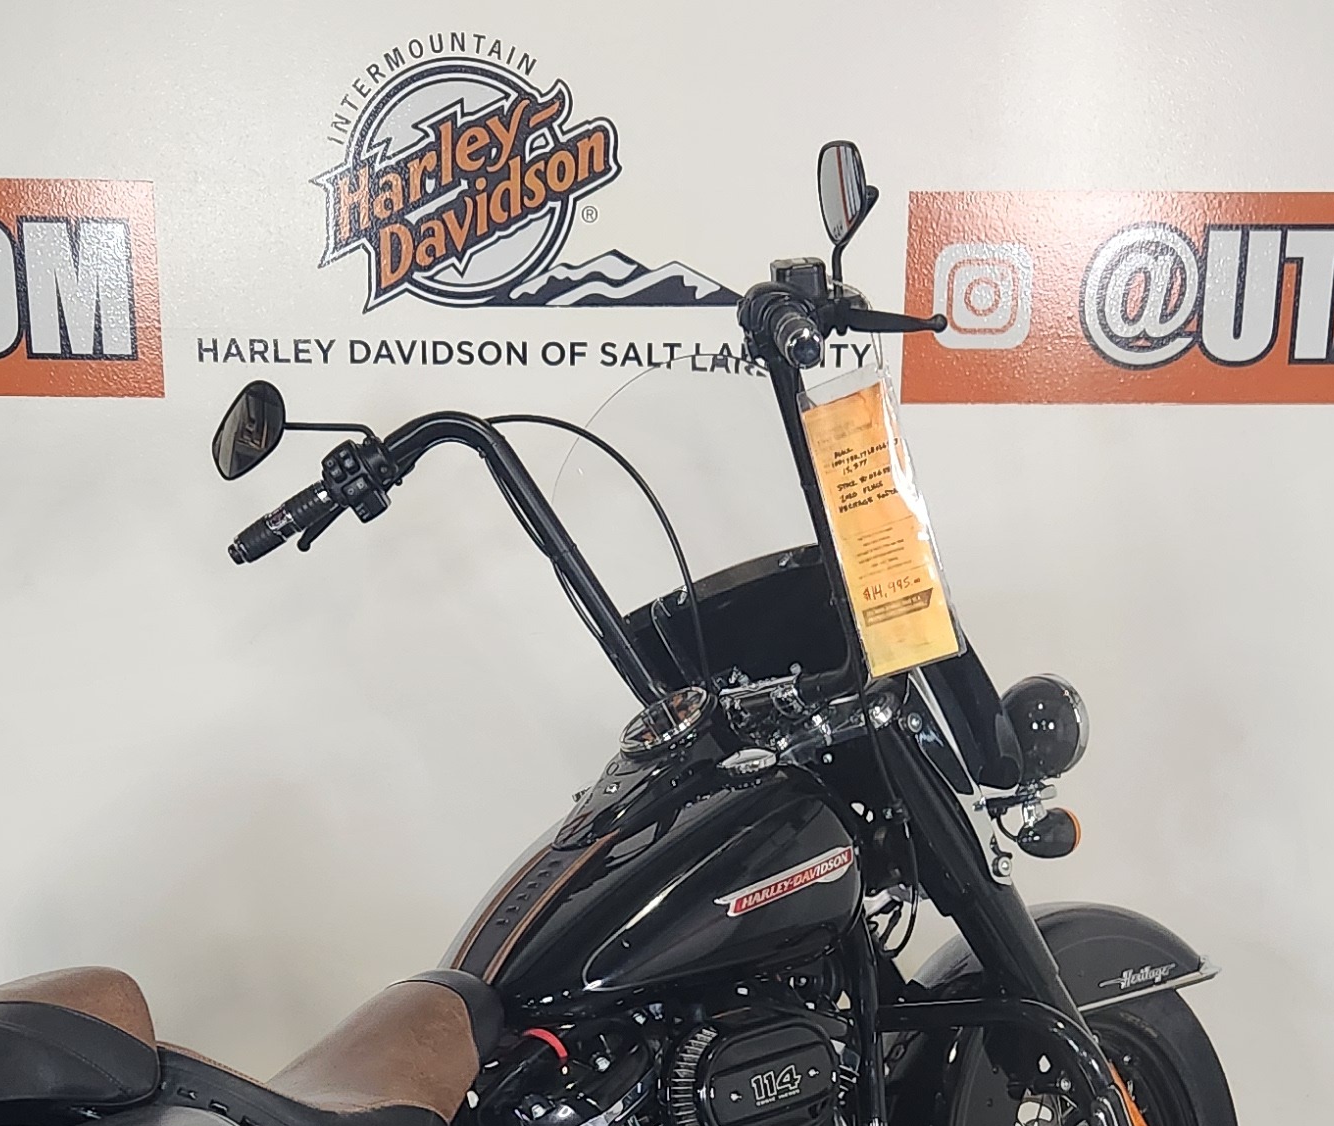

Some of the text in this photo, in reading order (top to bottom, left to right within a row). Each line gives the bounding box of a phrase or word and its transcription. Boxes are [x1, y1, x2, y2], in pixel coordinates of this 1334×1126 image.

[326, 31, 537, 146] INTERMOUNTAIN
[378, 130, 606, 289] Davidson
[197, 337, 872, 378] HARLEY DAVIDSON OF SALT LAK ITY
[741, 851, 848, 909] HARLEY-DAVIDSON
[1099, 962, 1176, 990] Heritage
[750, 1064, 802, 1101] 114
